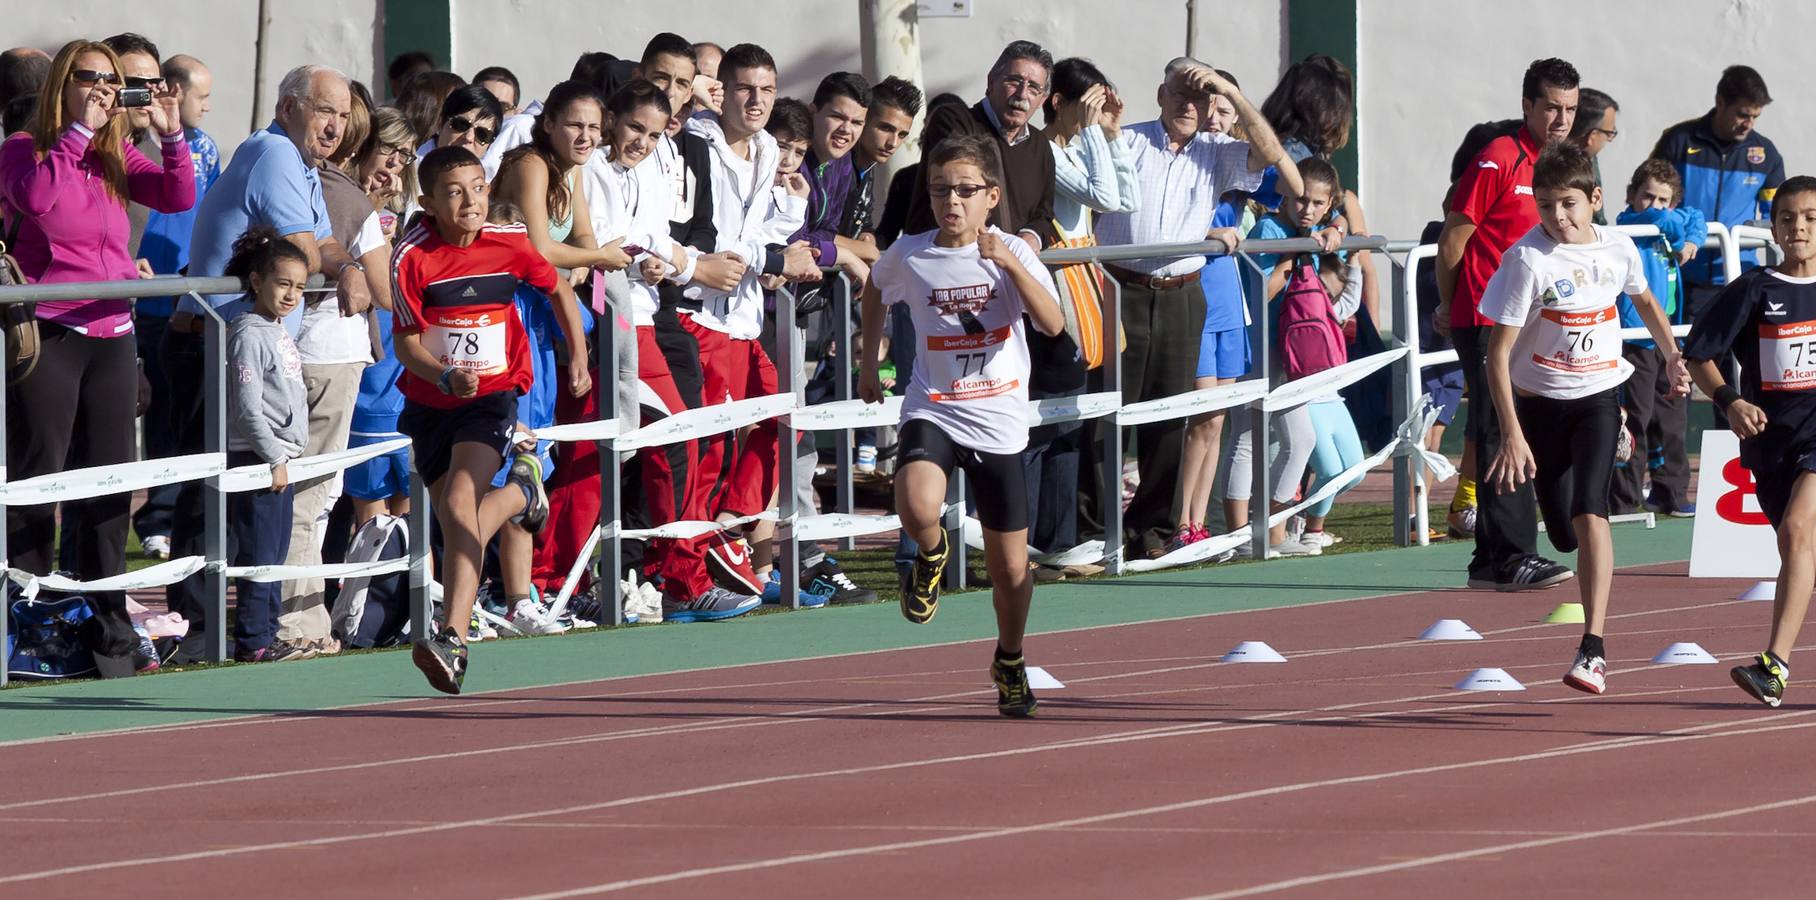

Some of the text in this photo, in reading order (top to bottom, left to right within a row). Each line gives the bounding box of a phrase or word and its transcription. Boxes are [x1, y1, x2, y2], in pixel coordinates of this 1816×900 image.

[951, 286, 988, 301] POPULAR
[448, 332, 479, 356] 78
[1567, 329, 1595, 352] 76
[956, 352, 986, 377] 77
[951, 378, 1001, 391] Alcampo
[1716, 457, 1772, 526] 8
